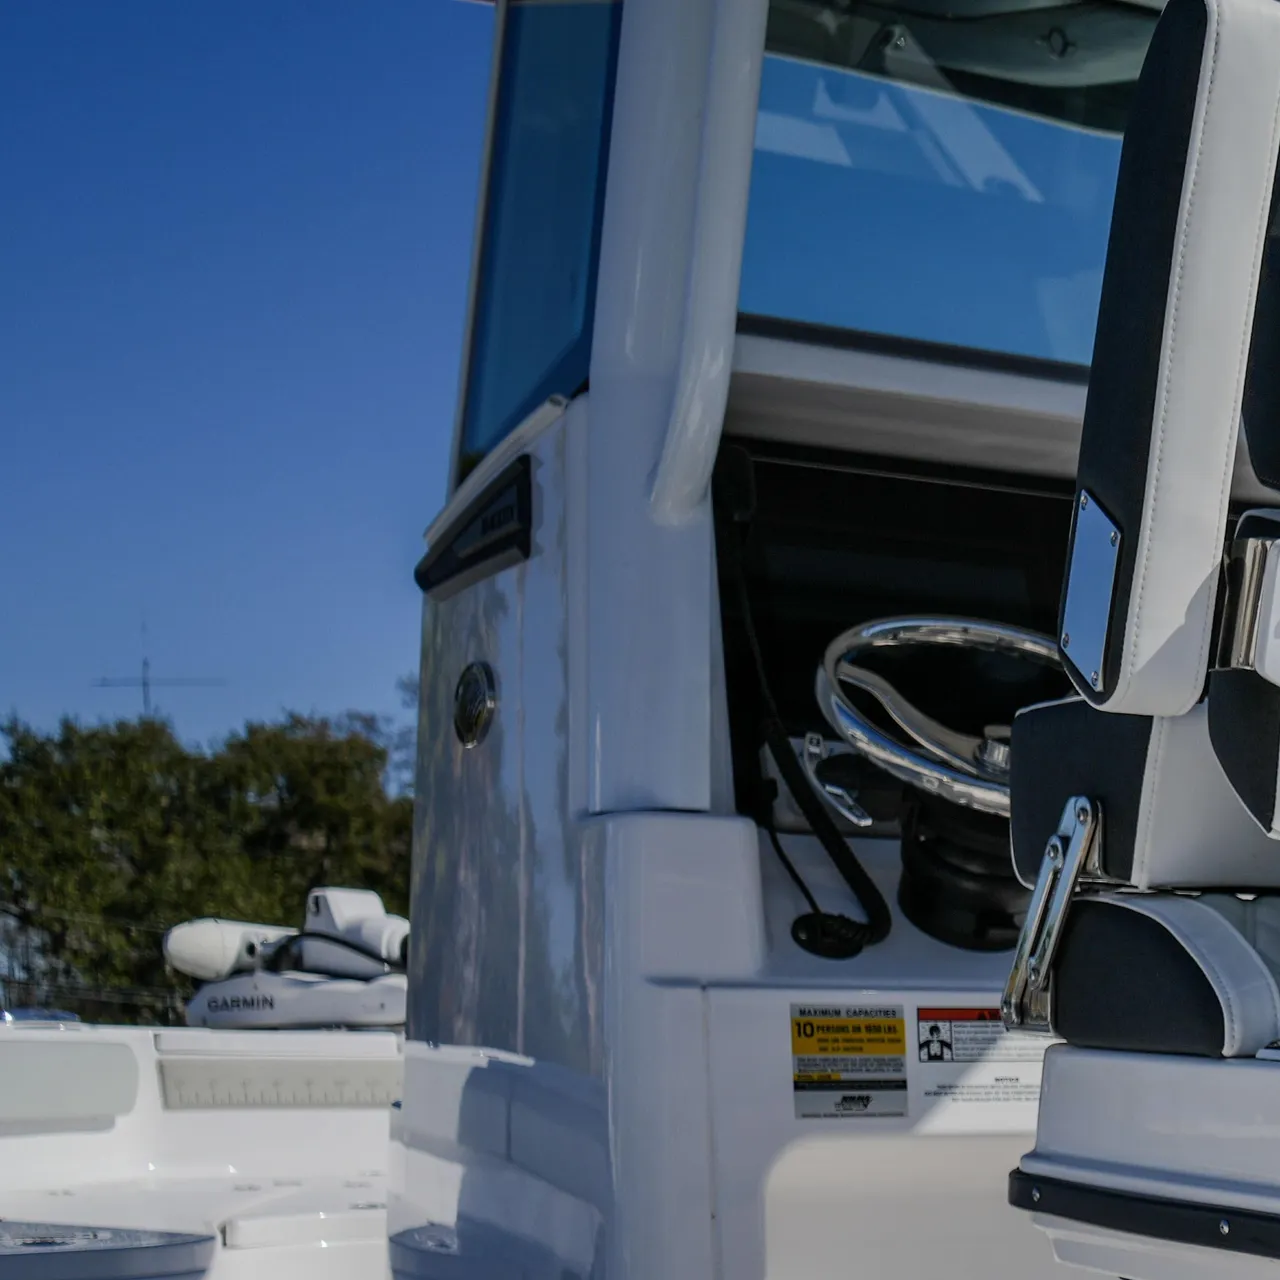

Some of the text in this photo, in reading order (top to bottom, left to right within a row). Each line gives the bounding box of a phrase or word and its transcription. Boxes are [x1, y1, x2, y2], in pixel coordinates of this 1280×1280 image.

[207, 994, 274, 1013] GARMIN
[799, 1008, 897, 1018] MAXIMUM CAPACITIES
[796, 1021, 815, 1038] 10
